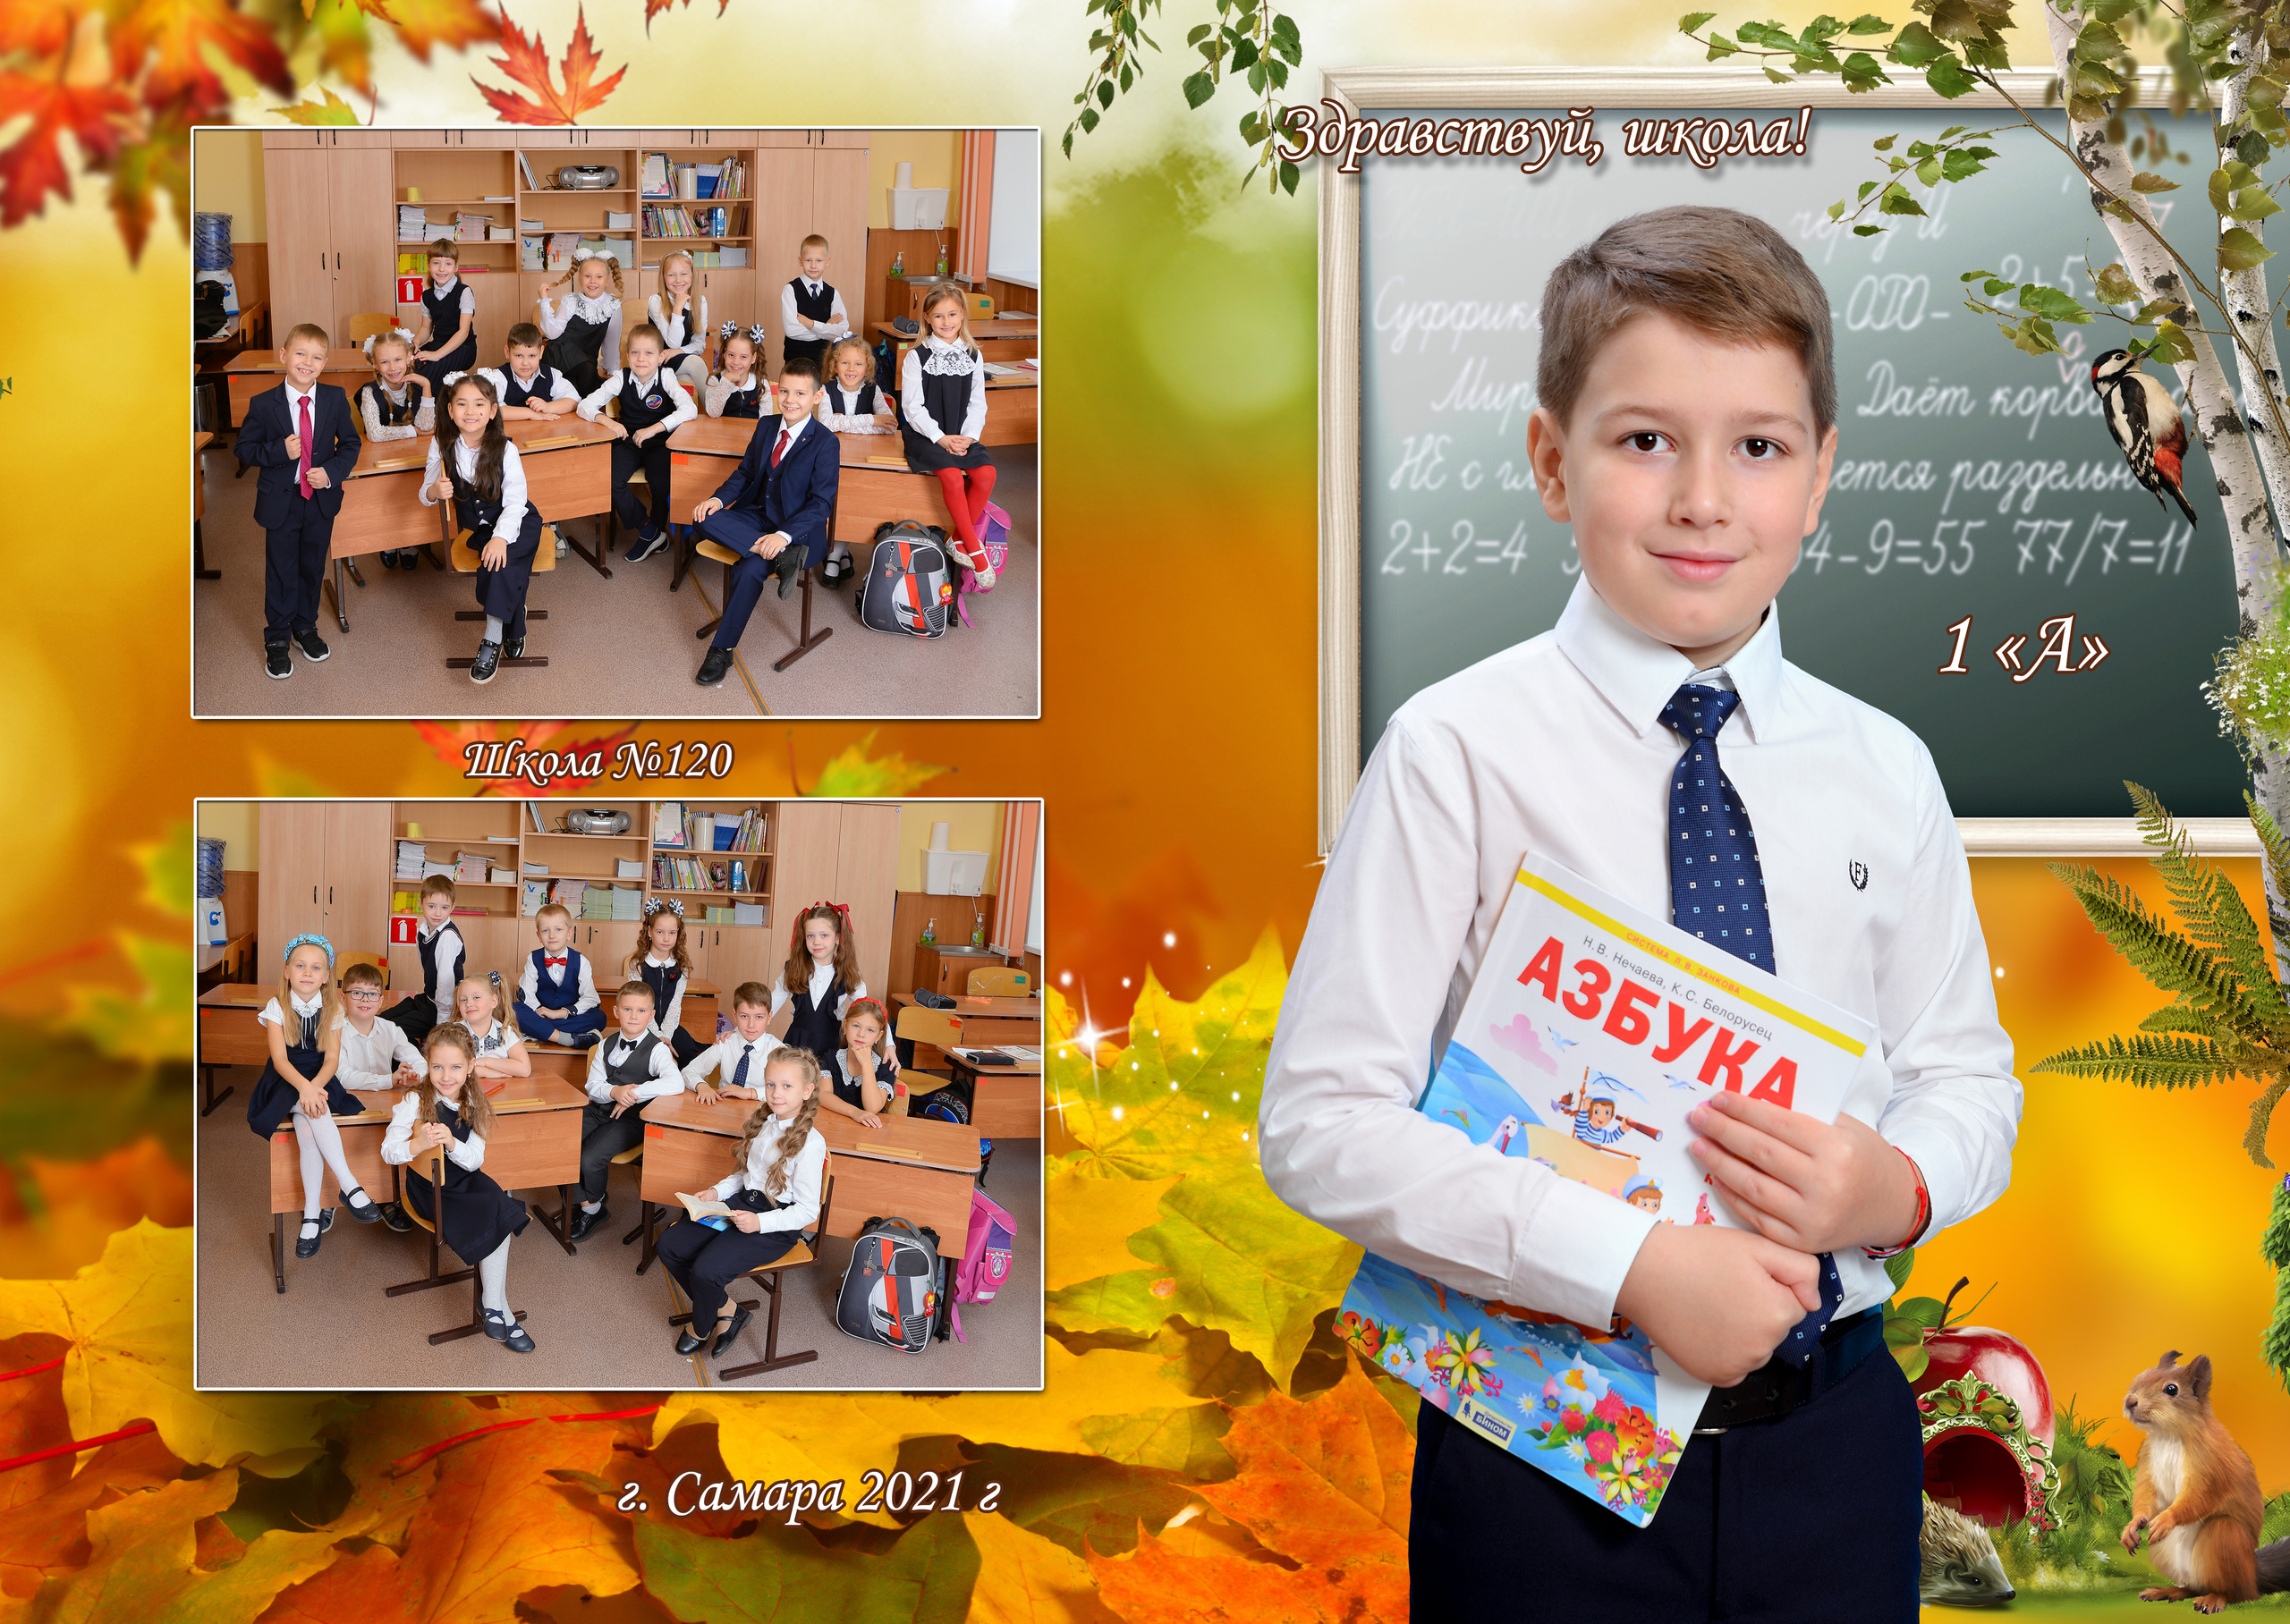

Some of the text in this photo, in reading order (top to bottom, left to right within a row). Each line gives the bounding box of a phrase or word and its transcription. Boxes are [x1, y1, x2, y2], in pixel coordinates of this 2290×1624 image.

[1380, 518, 1528, 575] 2+2=4
[1626, 932, 1669, 960] СИСТЕМА
[1696, 968, 1741, 994] ЗАНКОВА
[1516, 935, 1799, 1111] АЗБУКА
[1612, 952, 1667, 990] Нечаева,
[1702, 997, 1773, 1042] Белорусец
[1475, 1414, 1508, 1439] БИНОМ
